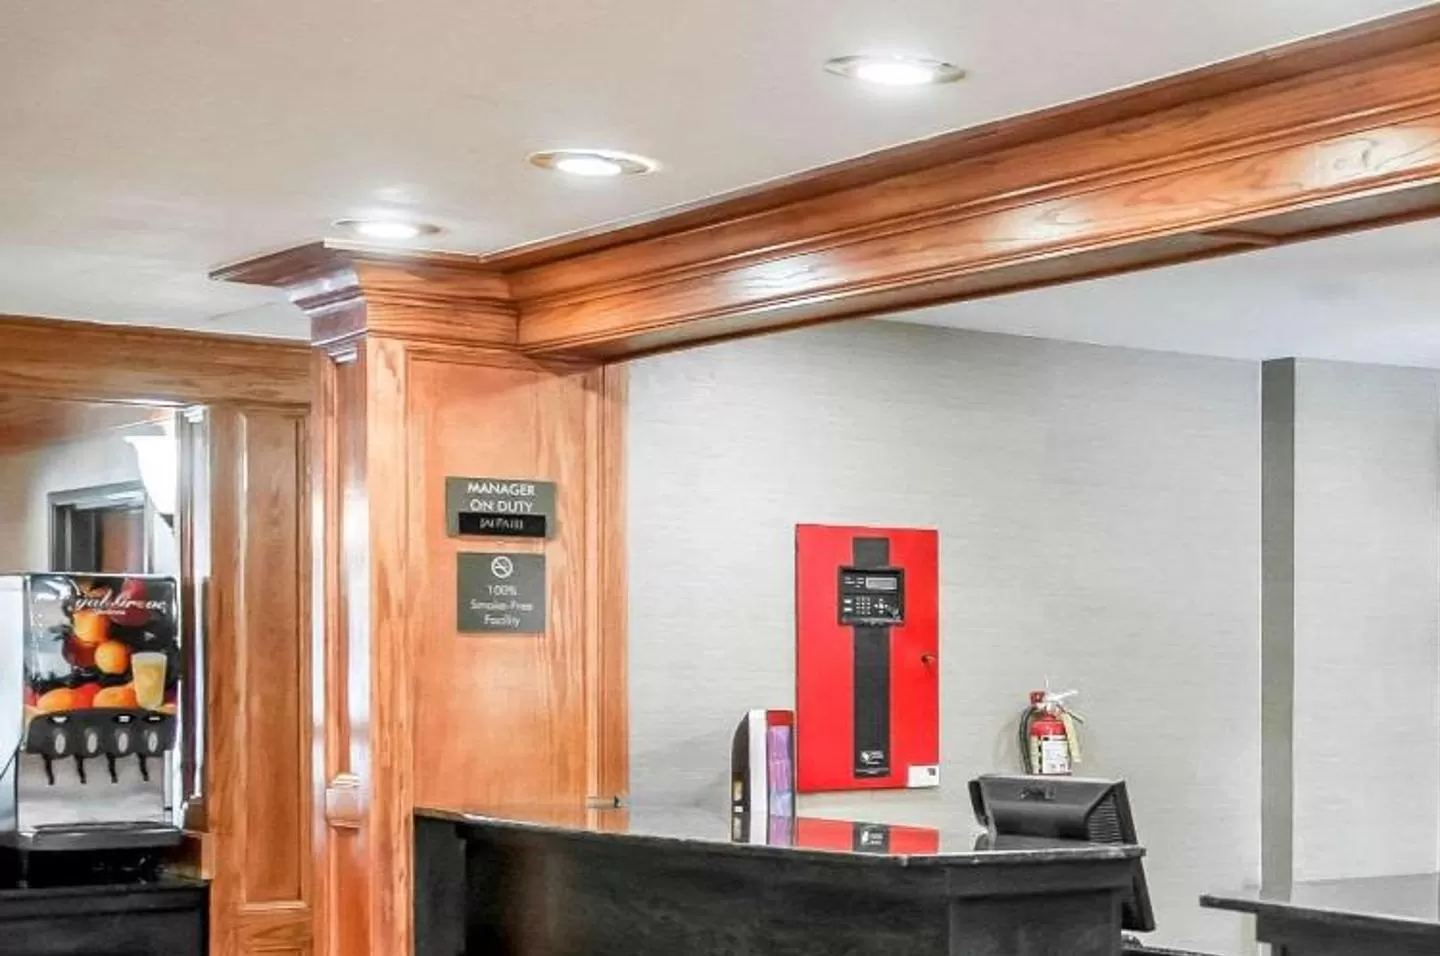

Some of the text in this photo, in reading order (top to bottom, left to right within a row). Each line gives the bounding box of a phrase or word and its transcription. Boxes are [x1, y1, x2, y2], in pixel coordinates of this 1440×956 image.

[467, 483, 536, 496] MANAGER
[470, 499, 534, 513] ON DUTY
[483, 613, 521, 628] Facility
